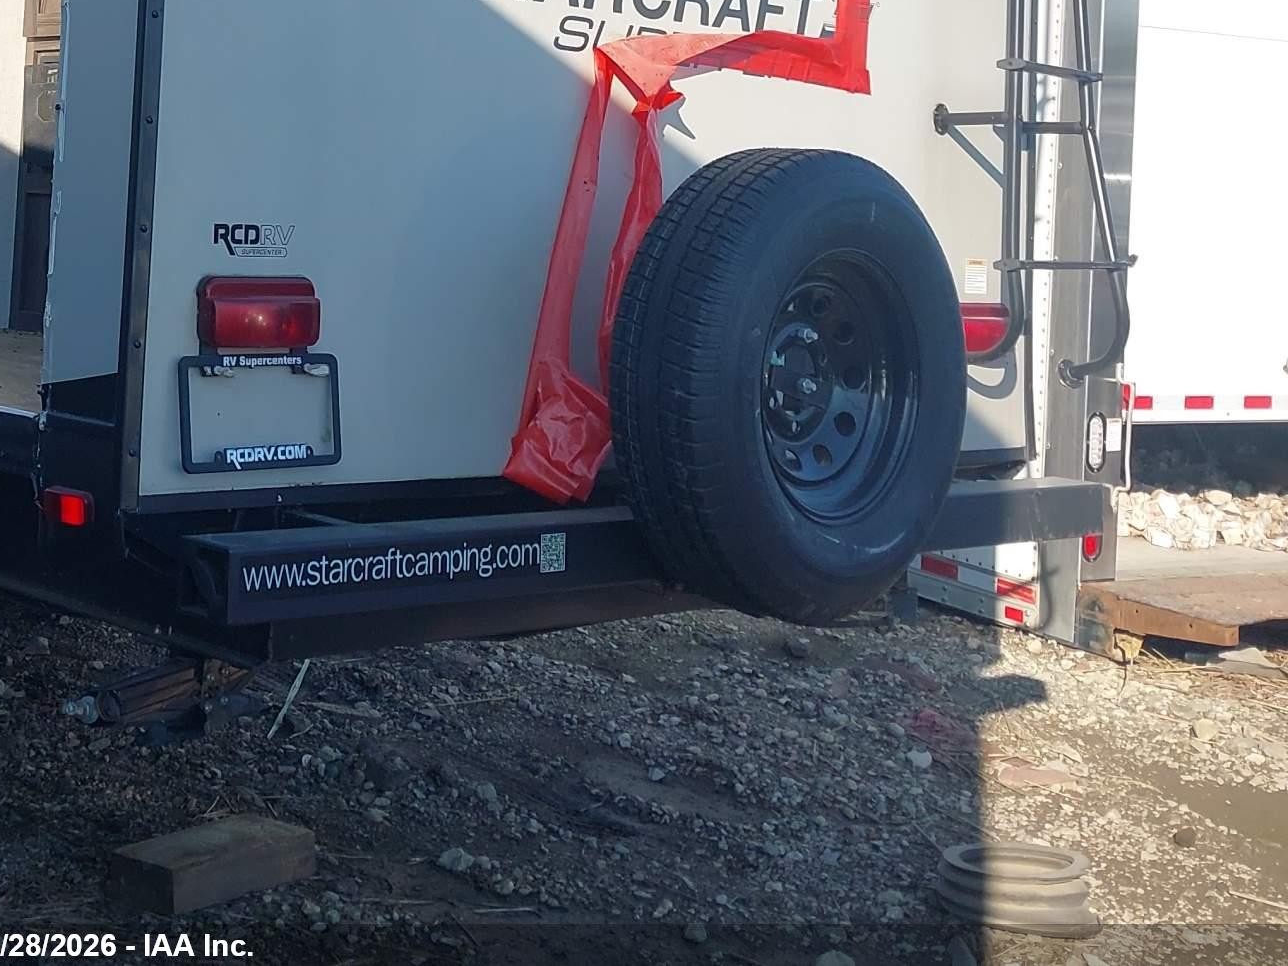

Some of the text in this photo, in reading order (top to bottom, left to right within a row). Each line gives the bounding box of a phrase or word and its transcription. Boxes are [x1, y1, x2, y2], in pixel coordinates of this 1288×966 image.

[213, 223, 296, 256] RCDRV
[223, 355, 302, 368] RV Supercenters
[226, 444, 307, 470] RCDRV.COM
[242, 541, 541, 592] www.starcraftcamping.com
